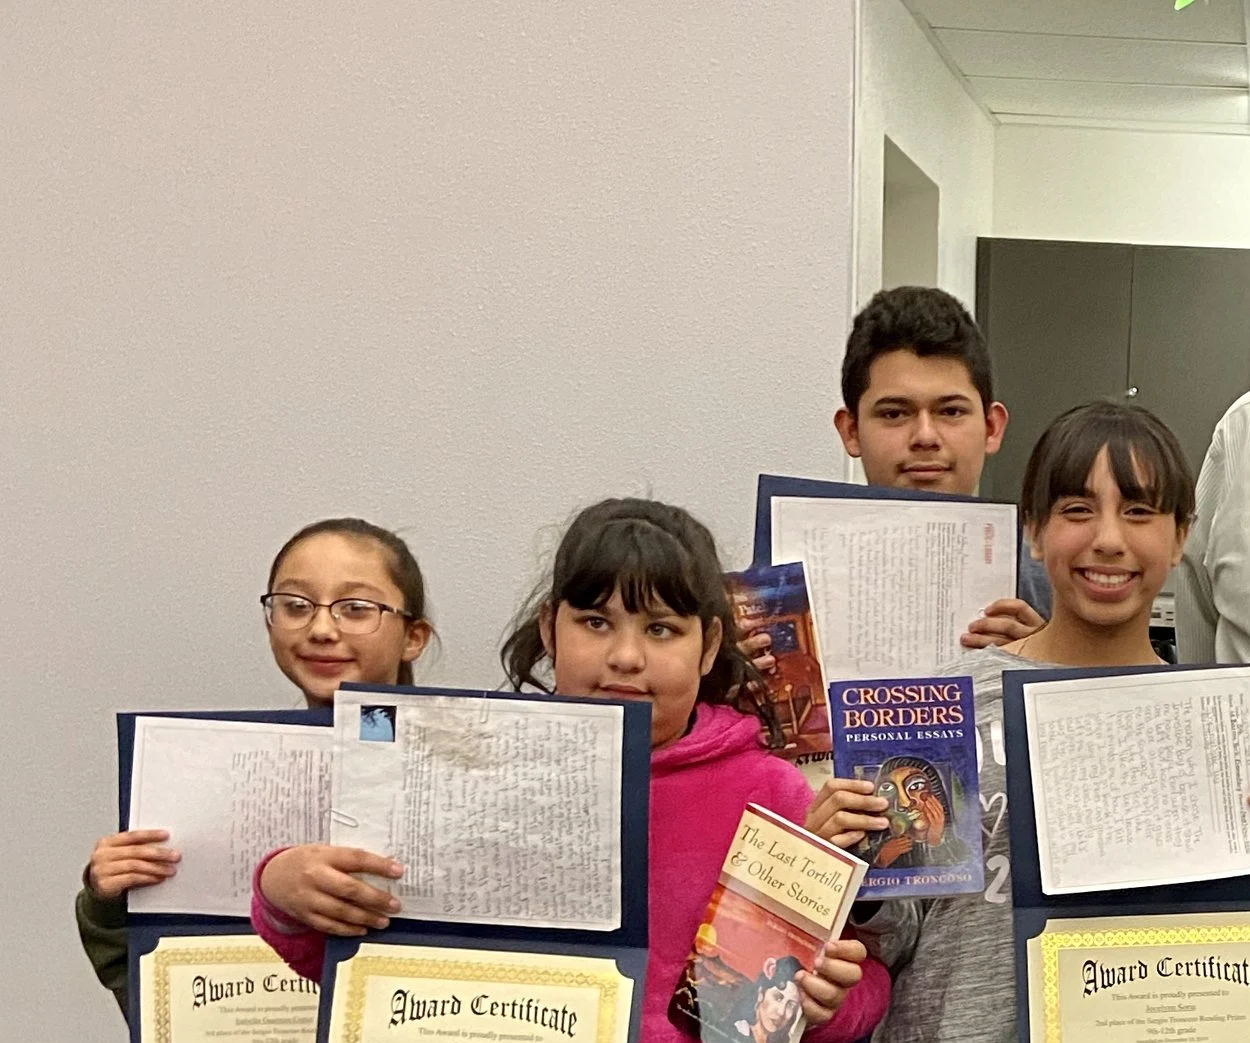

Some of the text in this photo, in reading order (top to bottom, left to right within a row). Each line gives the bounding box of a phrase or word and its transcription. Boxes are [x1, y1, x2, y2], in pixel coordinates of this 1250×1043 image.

[842, 684, 961, 705] CROSSING
[844, 705, 963, 728] BORDERS
[846, 729, 963, 742] PERSONAL ESSAYS
[741, 824, 843, 893] The Last Tortilla
[730, 851, 830, 917] & Other Stories
[861, 874, 972, 887] ERGIO TRONCOSO
[1082, 960, 1148, 999] Award
[192, 975, 254, 1011] Award
[1112, 993, 1128, 1001] This
[1129, 992, 1151, 1000] Award
[1160, 991, 1186, 1000] proudly
[1188, 990, 1220, 999] presented
[389, 989, 578, 1038] Award Certificate
[1095, 1019, 1108, 1027] 2nd
[1109, 1018, 1125, 1027] place
[1147, 1017, 1168, 1025] Sergio
[1200, 1015, 1225, 1023] Reading
[419, 1027, 434, 1035] This
[436, 1028, 460, 1037] Award
[469, 1031, 498, 1042] proudly
[499, 1033, 534, 1042] presented
[1177, 1027, 1196, 1035] grade
